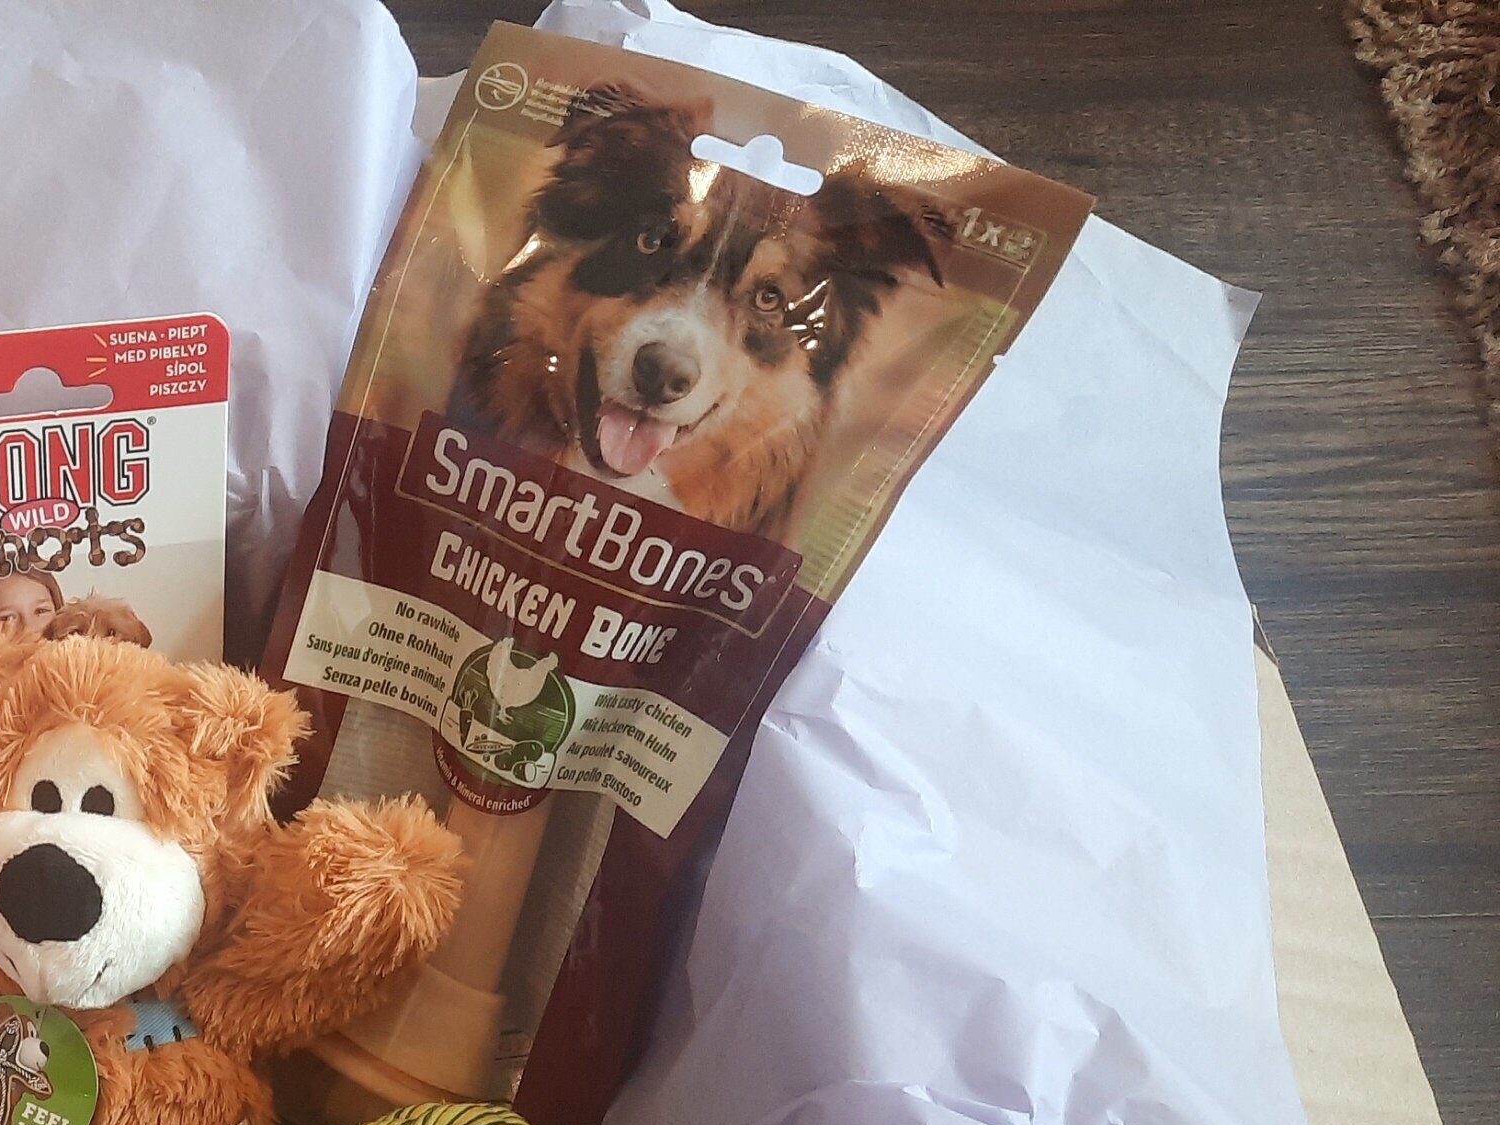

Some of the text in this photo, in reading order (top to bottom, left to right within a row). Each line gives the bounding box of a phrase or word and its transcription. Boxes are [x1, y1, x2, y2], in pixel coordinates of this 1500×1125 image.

[109, 324, 208, 346] SUENA PIEPT
[115, 343, 208, 364] MED PIBELYD
[149, 379, 207, 397] PISZCZY
[166, 361, 207, 377] SÍPOL
[9, 502, 70, 531] WILD
[425, 427, 765, 611] SmartBones
[430, 530, 577, 640] CHICKEN
[395, 601, 460, 643] No rawhide
[306, 634, 446, 693] Sans peau d'origine animale
[368, 621, 453, 669] Ohne Rohhaut
[322, 665, 438, 717] Senza pelle bovina
[594, 693, 618, 709] With
[645, 704, 692, 738] chicken
[580, 717, 677, 763] Mit leckerem Huhn
[557, 766, 642, 807] Con pollo gustoso
[566, 741, 673, 794] Au poulet savoureux
[451, 776, 458, 786] &
[486, 794, 532, 812] enriched
